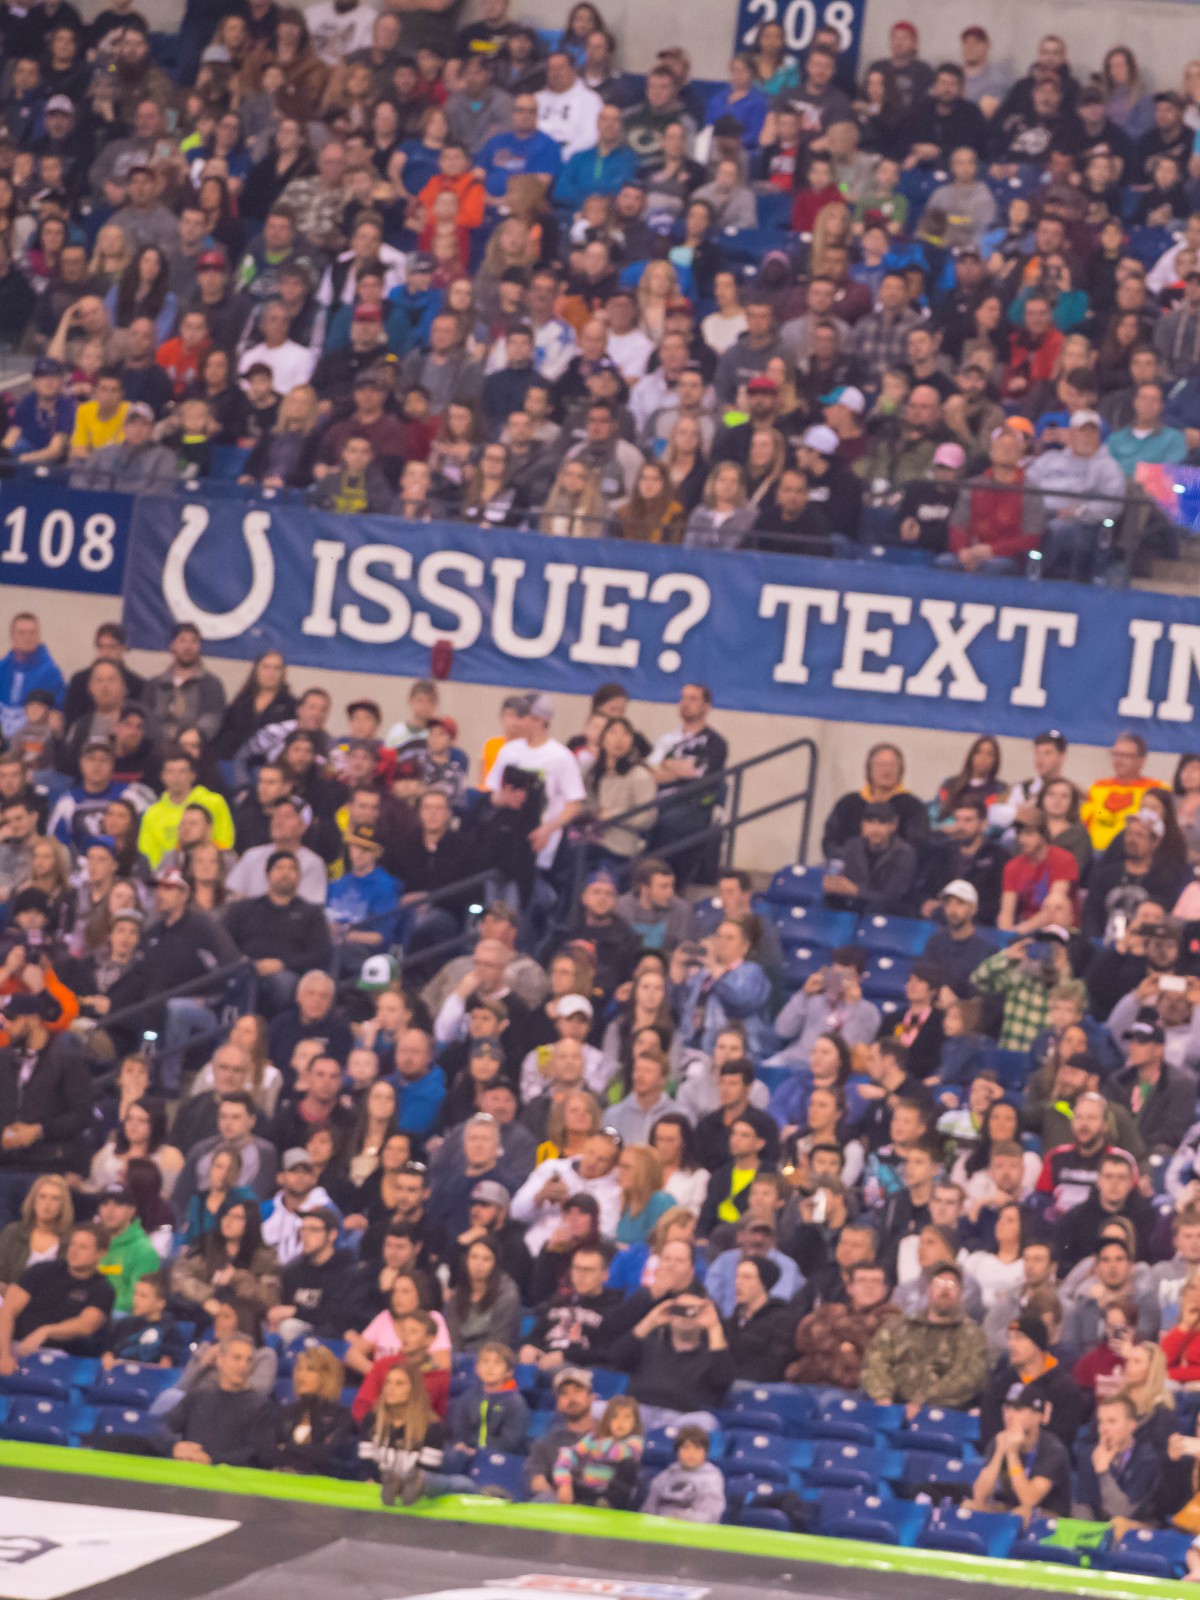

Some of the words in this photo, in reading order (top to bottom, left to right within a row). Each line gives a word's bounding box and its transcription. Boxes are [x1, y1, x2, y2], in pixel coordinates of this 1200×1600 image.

[742, 0, 854, 51] 208
[1, 505, 116, 572] 108
[303, 540, 711, 674] ISSUE?
[759, 584, 1078, 707] TEXT
